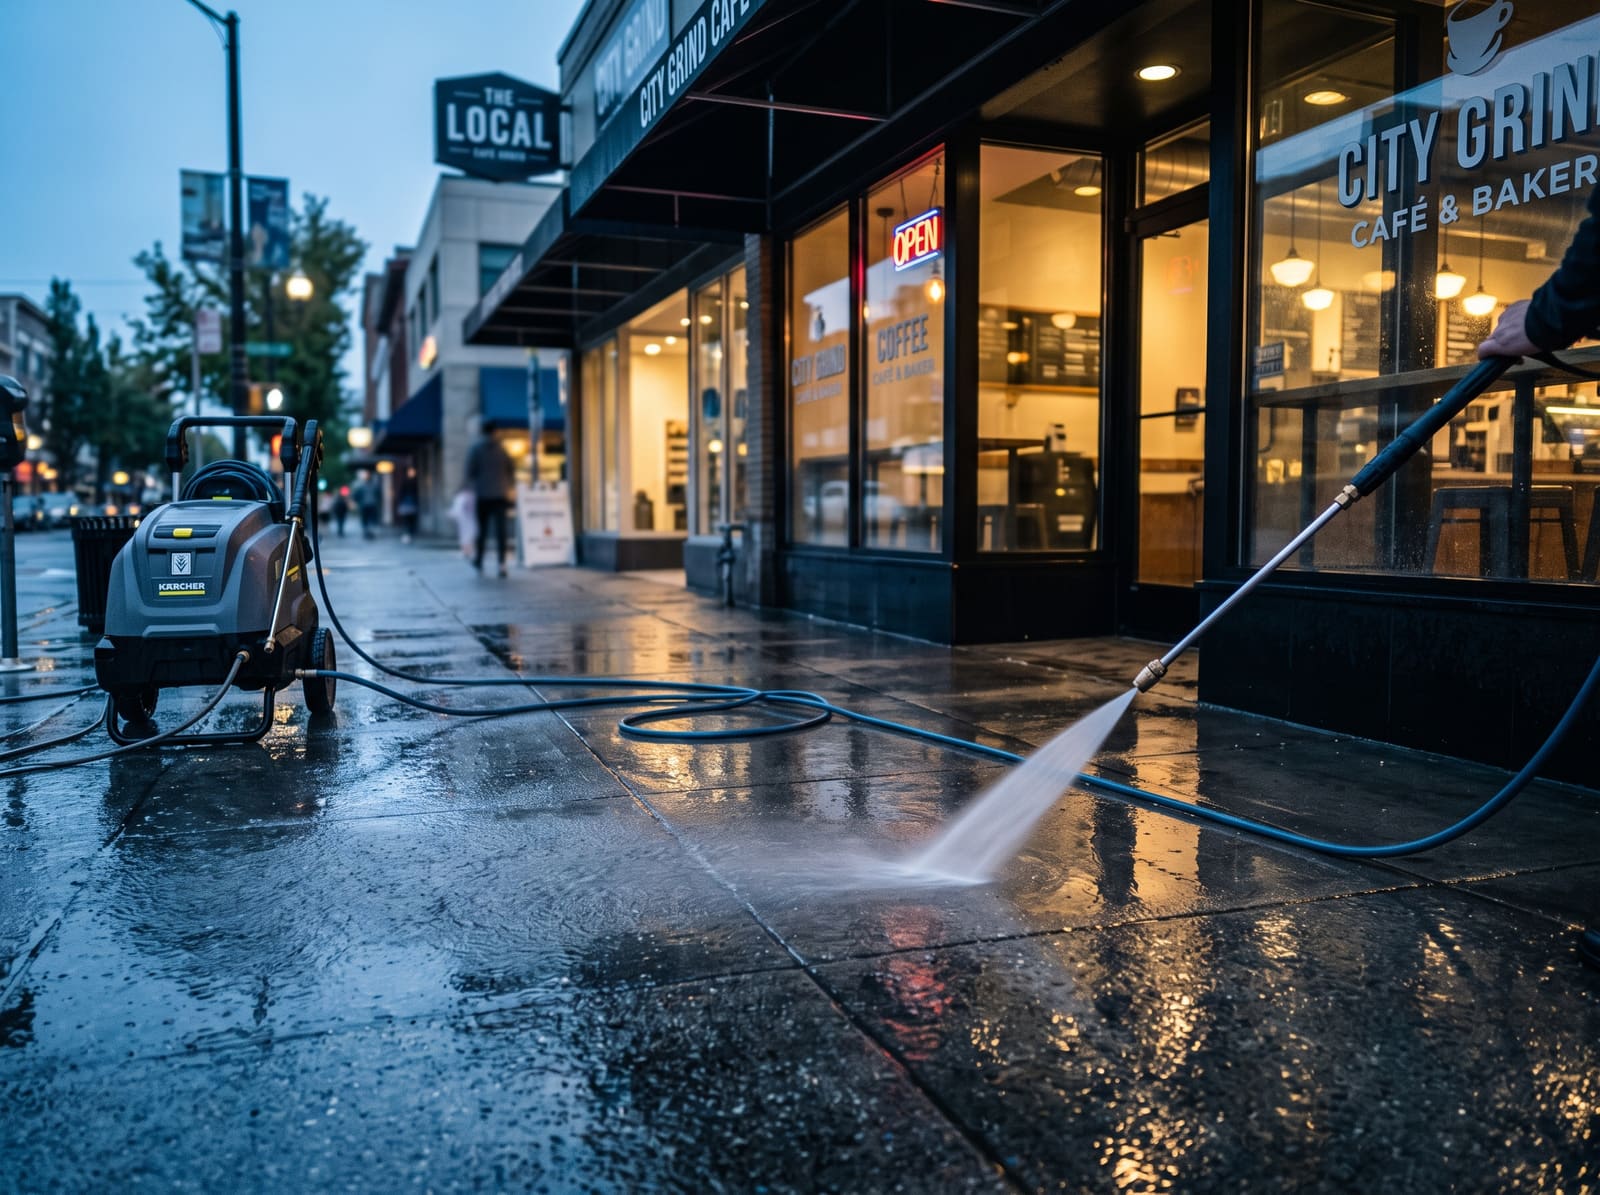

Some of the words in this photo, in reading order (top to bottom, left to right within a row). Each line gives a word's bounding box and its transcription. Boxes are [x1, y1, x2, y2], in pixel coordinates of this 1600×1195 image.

[484, 87, 514, 107] THE
[640, 65, 665, 128] CITY
[668, 16, 706, 96] GRIND
[447, 103, 552, 149] LOCAL
[1338, 111, 1441, 207] CITY
[1457, 50, 1600, 169] GRIN
[893, 216, 938, 267] OPEN
[1351, 196, 1428, 248] CAFÉ
[1439, 194, 1459, 225] &
[877, 313, 929, 364] COFFEE
